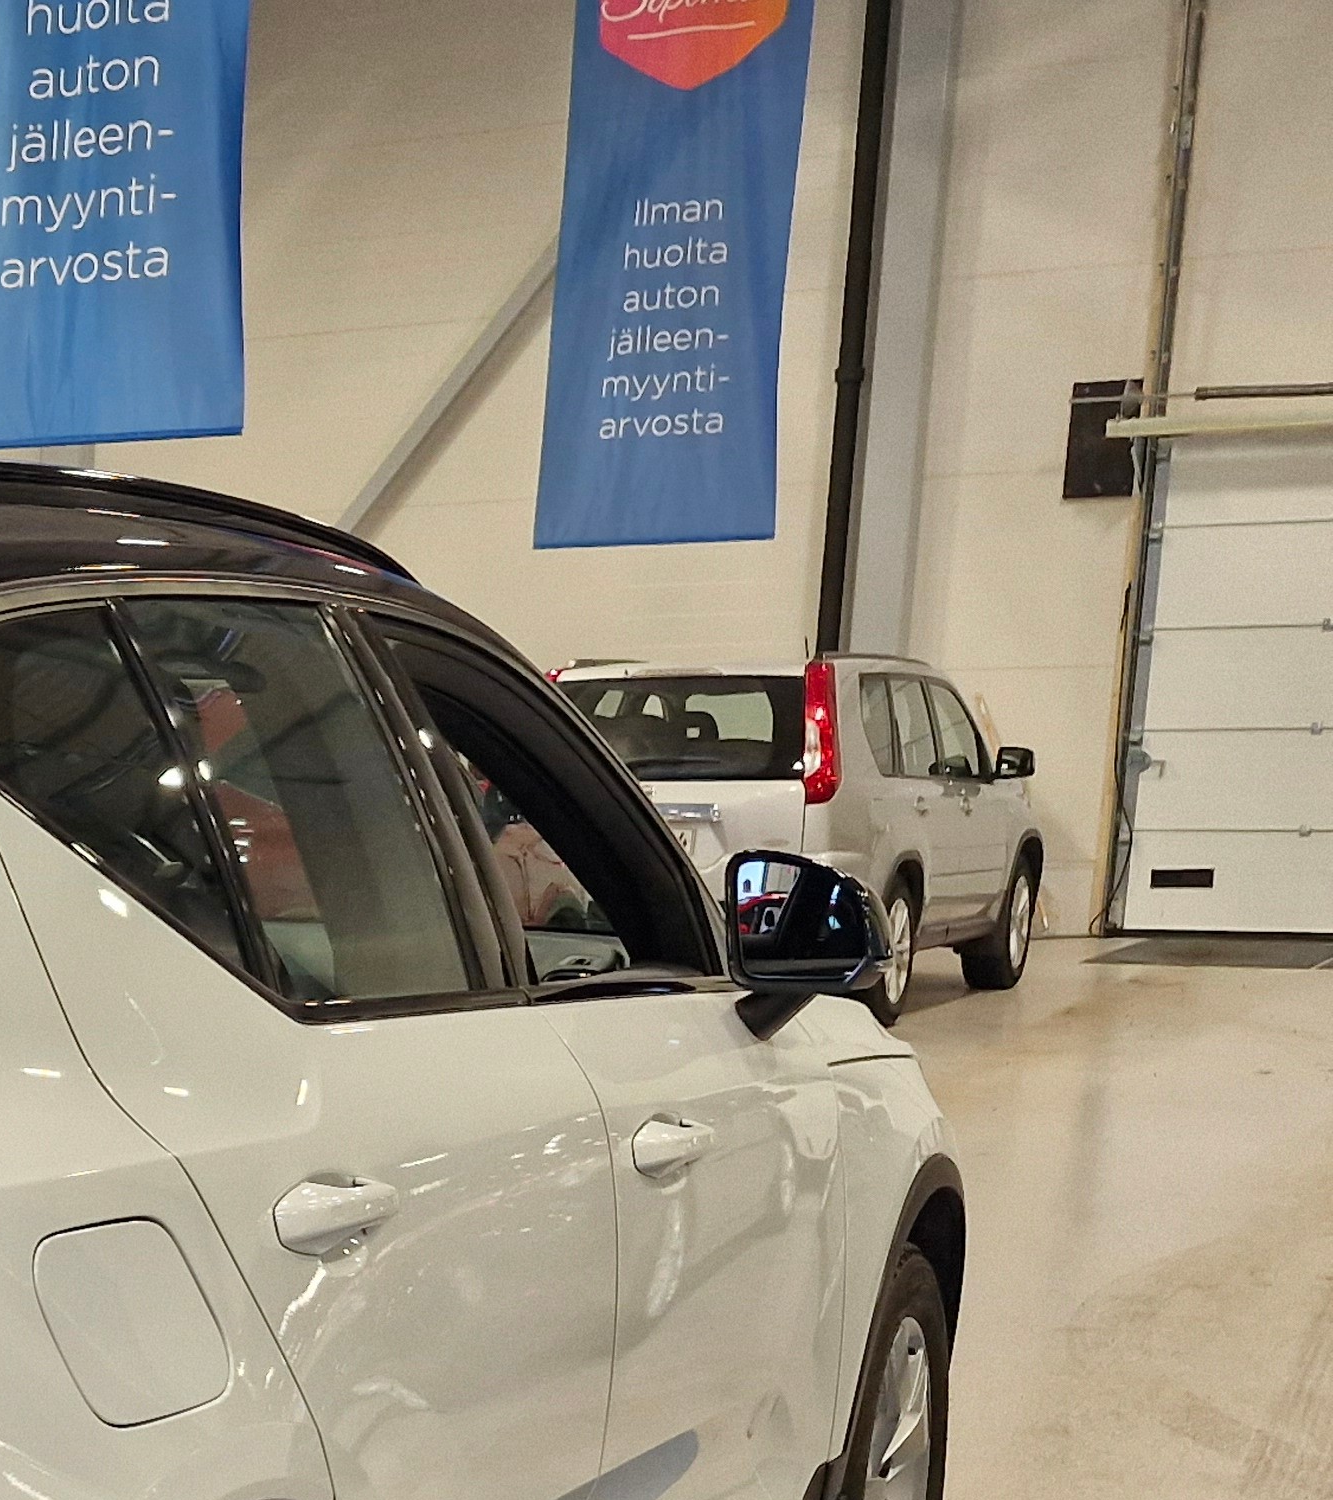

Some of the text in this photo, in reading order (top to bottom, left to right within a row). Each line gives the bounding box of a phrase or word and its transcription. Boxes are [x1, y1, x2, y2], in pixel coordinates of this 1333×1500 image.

[28, 54, 160, 100] auton
[5, 118, 175, 173] jälleen-
[0, 177, 178, 233] myynti-
[633, 198, 724, 228] Ilman
[0, 241, 170, 290] arvosta
[623, 236, 729, 271] huolta
[623, 281, 721, 313] auton
[606, 325, 730, 361] jälleen-
[601, 365, 730, 402] myynti-
[599, 408, 725, 440] arvosta
